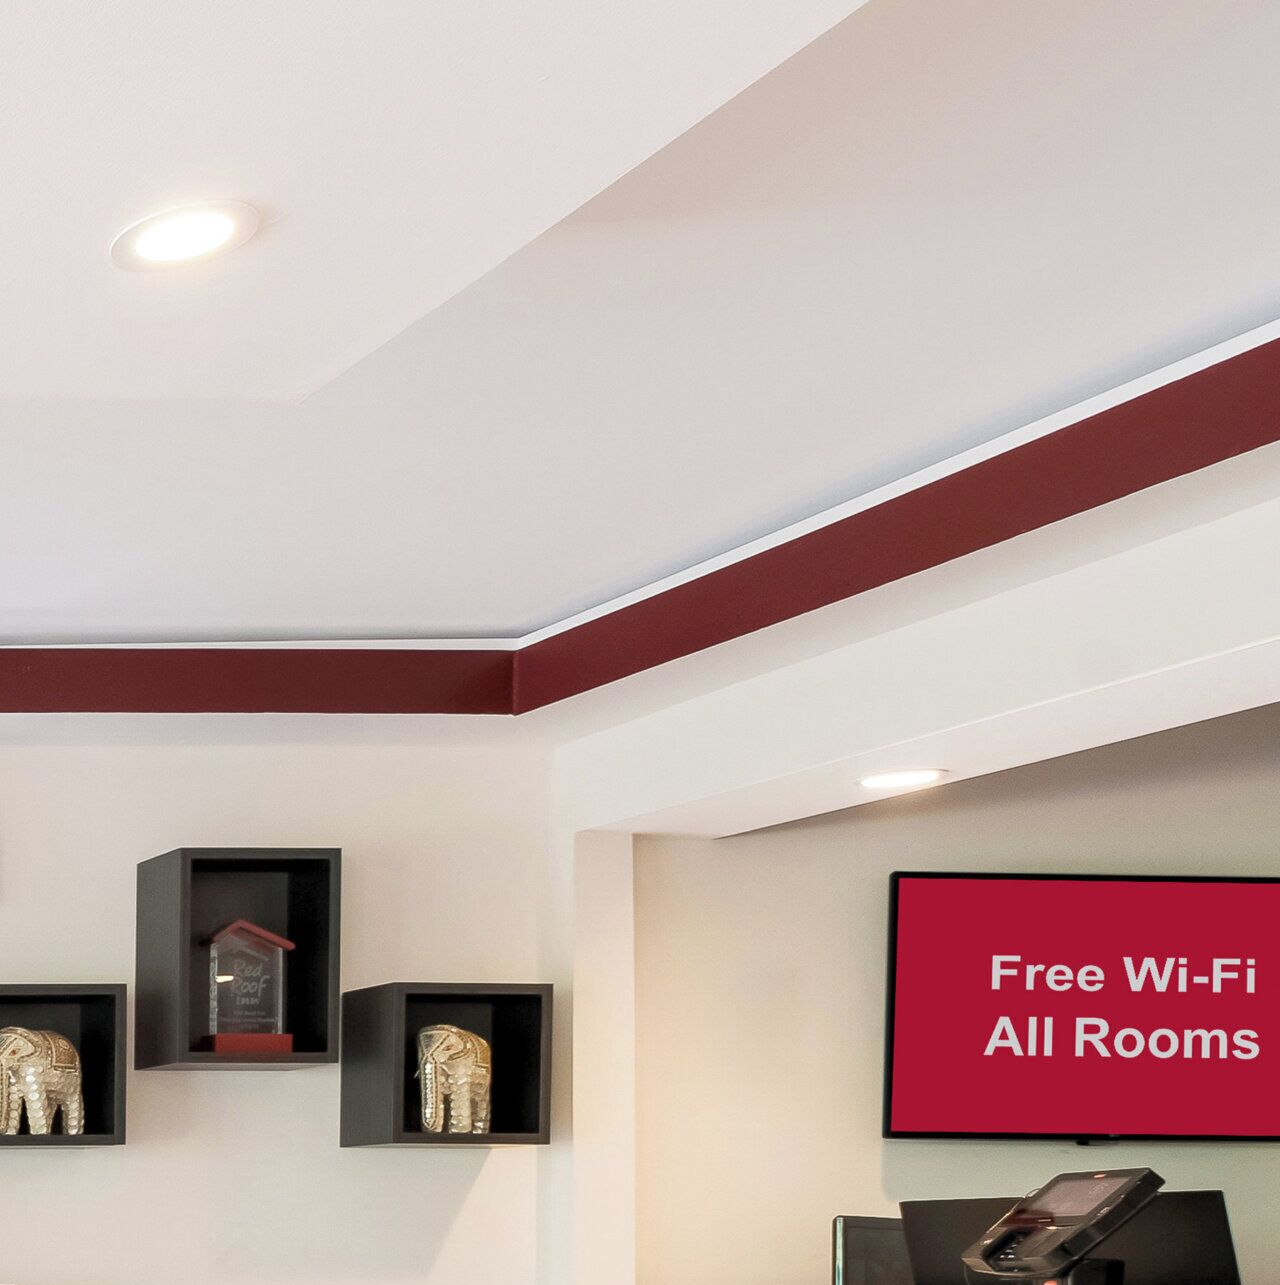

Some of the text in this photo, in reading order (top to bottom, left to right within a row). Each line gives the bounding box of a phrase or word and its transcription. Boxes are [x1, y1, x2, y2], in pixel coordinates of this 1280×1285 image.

[234, 959, 263, 977] Red
[990, 954, 1257, 994] Free Wi-Fi
[983, 1015, 1261, 1061] All Rooms
